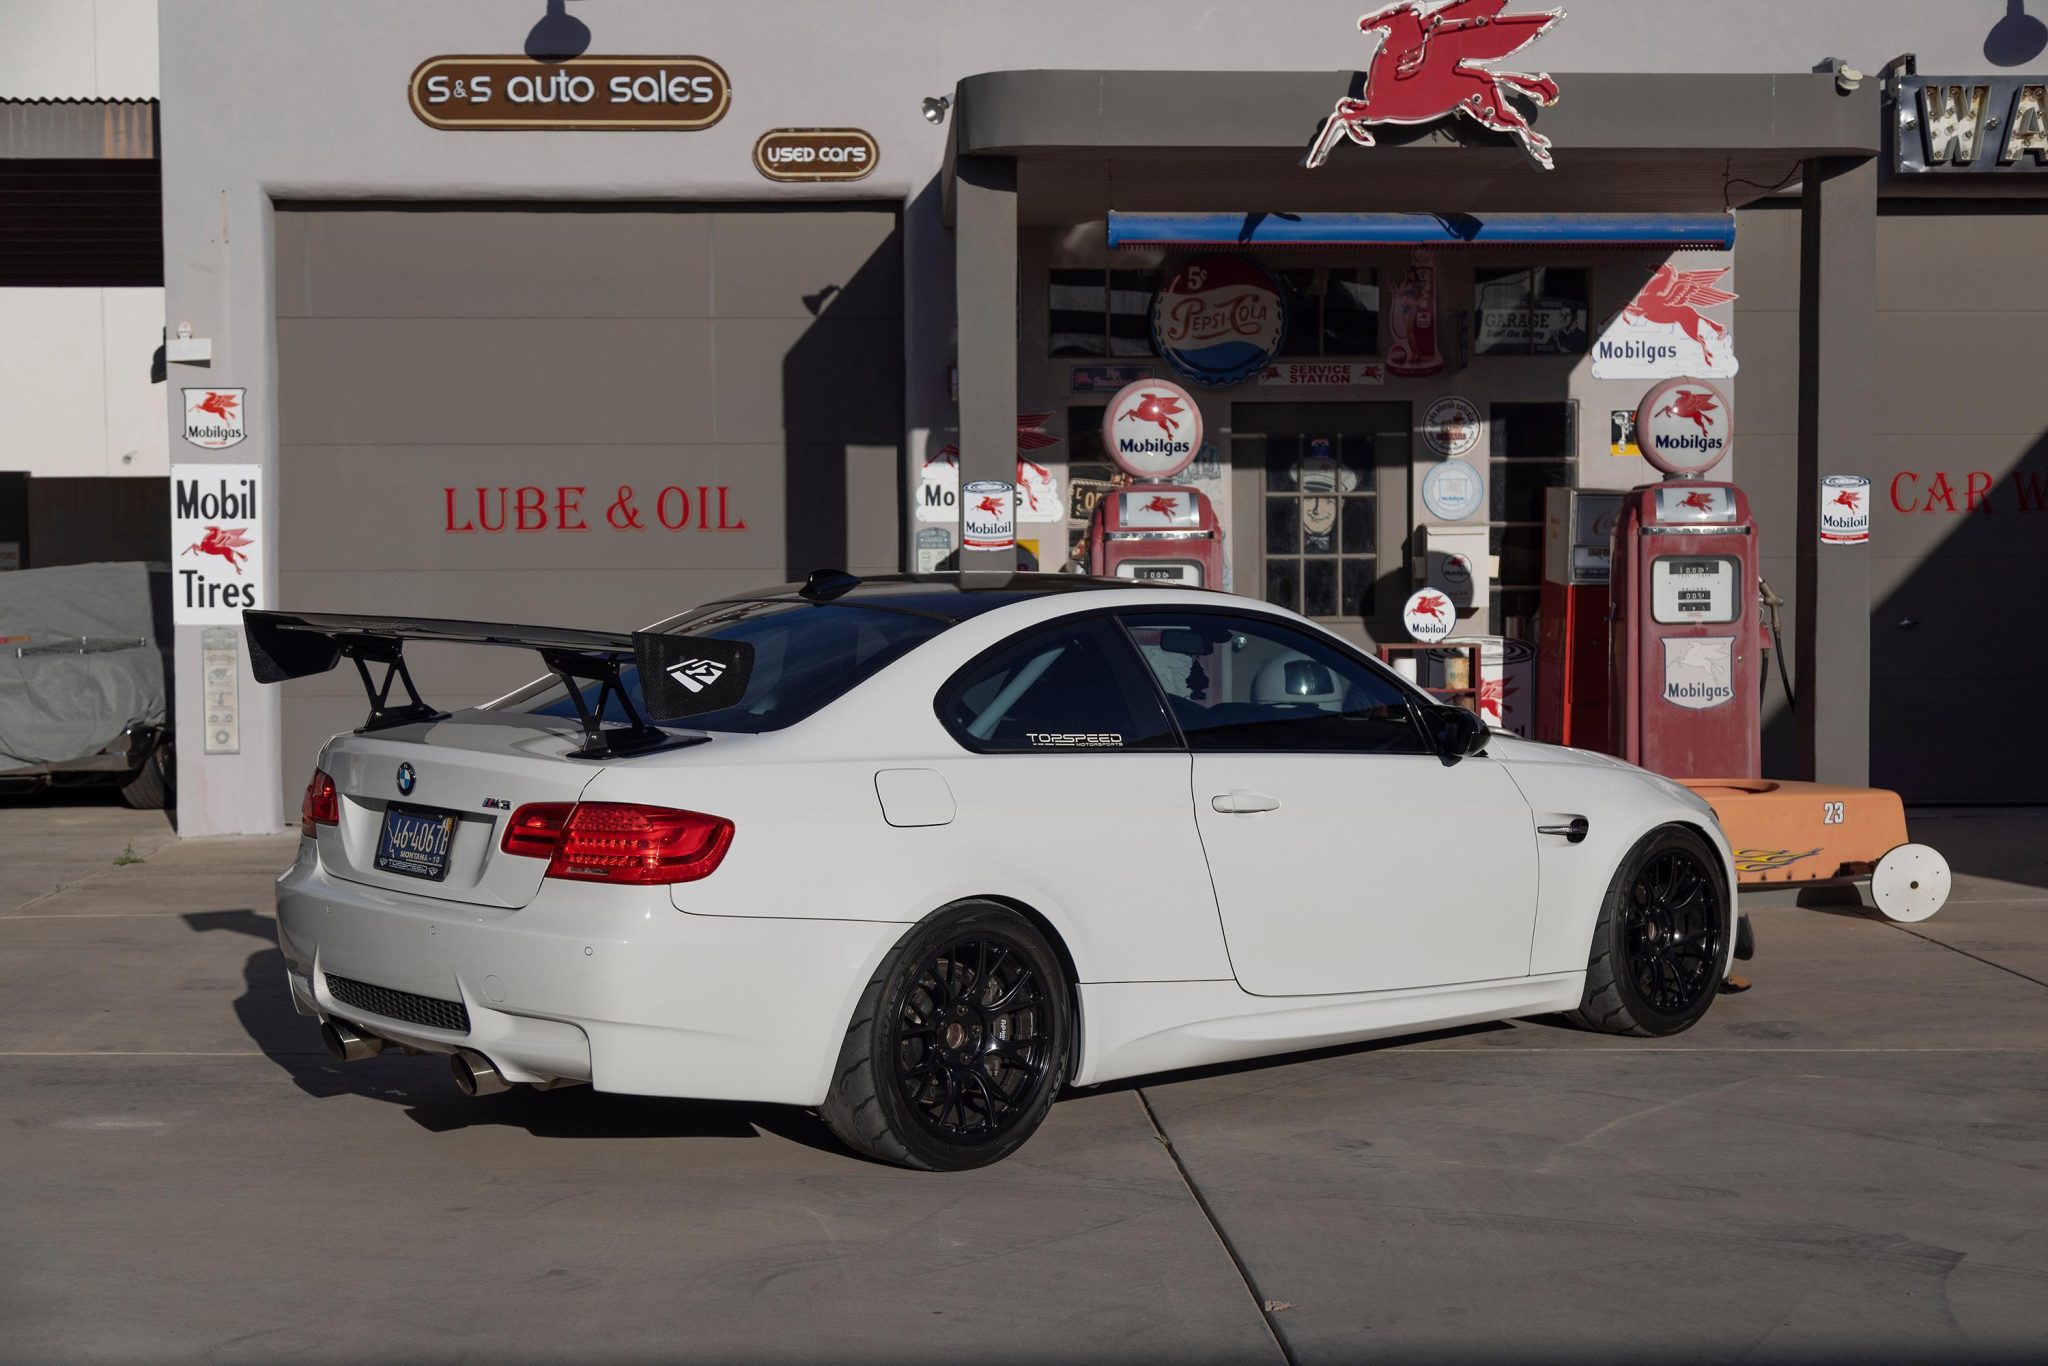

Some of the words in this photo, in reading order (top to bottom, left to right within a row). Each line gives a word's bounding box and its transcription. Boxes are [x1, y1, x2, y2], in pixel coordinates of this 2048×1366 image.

[427, 75, 492, 104] S&S
[507, 70, 594, 104] auto
[611, 69, 714, 104] sales
[1922, 84, 2048, 163] WA
[768, 146, 816, 162] USED
[1486, 313, 1550, 328] GARAGE
[1599, 340, 1677, 364] Mobilgas
[1289, 365, 1351, 374] SERVICE
[1289, 374, 1351, 384] STATION
[188, 425, 242, 441] Mobilgas
[1119, 438, 1190, 456] Mobilgas
[1655, 434, 1723, 453] Mobilgas
[177, 479, 256, 519] Mobil
[1890, 471, 1994, 514] CAR
[444, 486, 591, 533] LUBE
[606, 485, 647, 532] &
[656, 486, 748, 532] OIL
[966, 521, 1011, 535] Mobiloil
[1823, 515, 1867, 528] Mobiloil
[179, 569, 255, 608] Tires
[1412, 622, 1447, 635] Mobiloil
[1668, 683, 1730, 701] Mobilgas
[1026, 733, 1122, 743] TOPSPEED
[1823, 801, 1845, 825] 23
[399, 850, 428, 862] MONTANA
